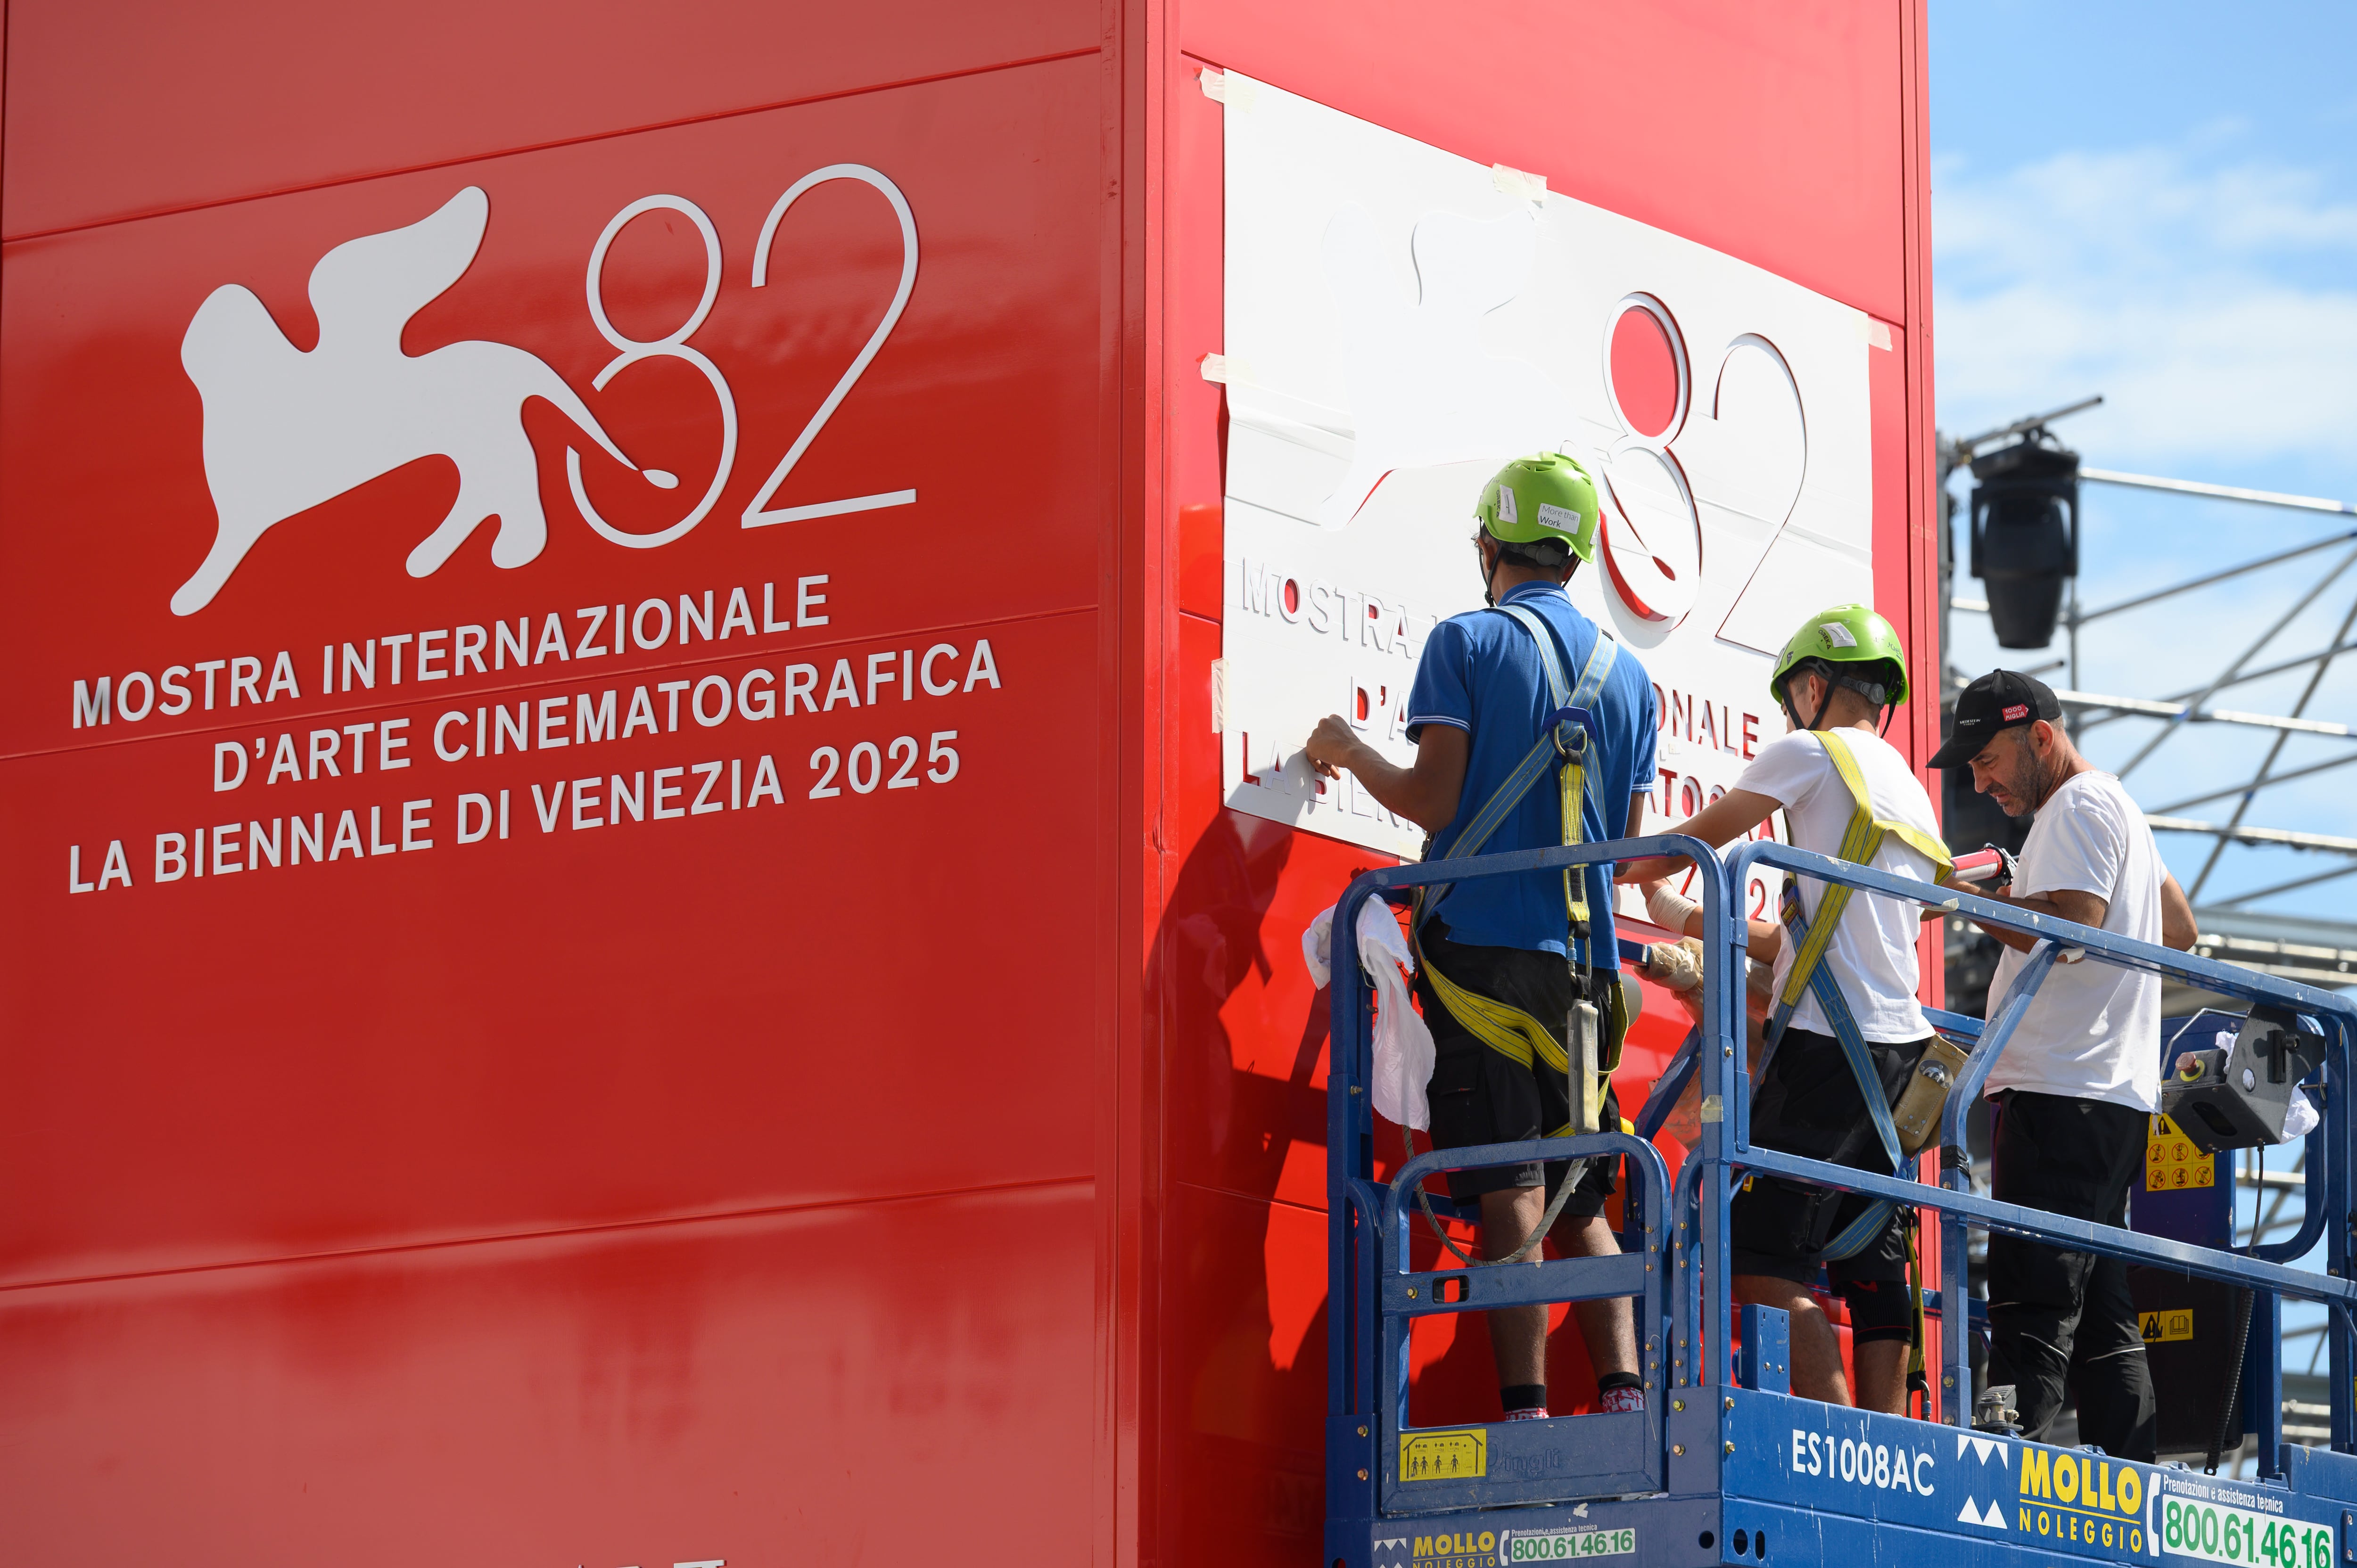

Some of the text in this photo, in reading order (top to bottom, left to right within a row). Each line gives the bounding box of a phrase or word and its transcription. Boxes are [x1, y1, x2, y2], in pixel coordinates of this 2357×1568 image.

[567, 163, 919, 549] 82
[1540, 516, 1561, 528] Work
[1542, 505, 1578, 522] More than
[1243, 556, 1413, 659] MOSTRA
[73, 574, 830, 729] MOSTRA INTERNAZIONALE
[1818, 629, 1831, 650] OREKA
[433, 639, 1001, 762] CINEMATOGRAFICA
[2005, 706, 2022, 714] 1000
[2005, 711, 2025, 720] MIGLIA
[1243, 731, 1291, 796] LA
[69, 730, 960, 894] LA BIENNALE DI VENEZIA 2025
[1792, 1428, 1935, 1496] ES1008AC
[2019, 1447, 2142, 1515] MOLLO
[2164, 1474, 2283, 1513] Prenotazioni e assistenza tecnica
[1413, 1531, 1495, 1557] MOLLO
[1511, 1527, 1544, 1537] Prenotazioni
[1550, 1526, 1577, 1534] assistenza
[1512, 1530, 1633, 1560] 800.61.46.16
[2019, 1507, 2142, 1553] NOLEGGIO
[2165, 1501, 2331, 1568] 800.61.46.16
